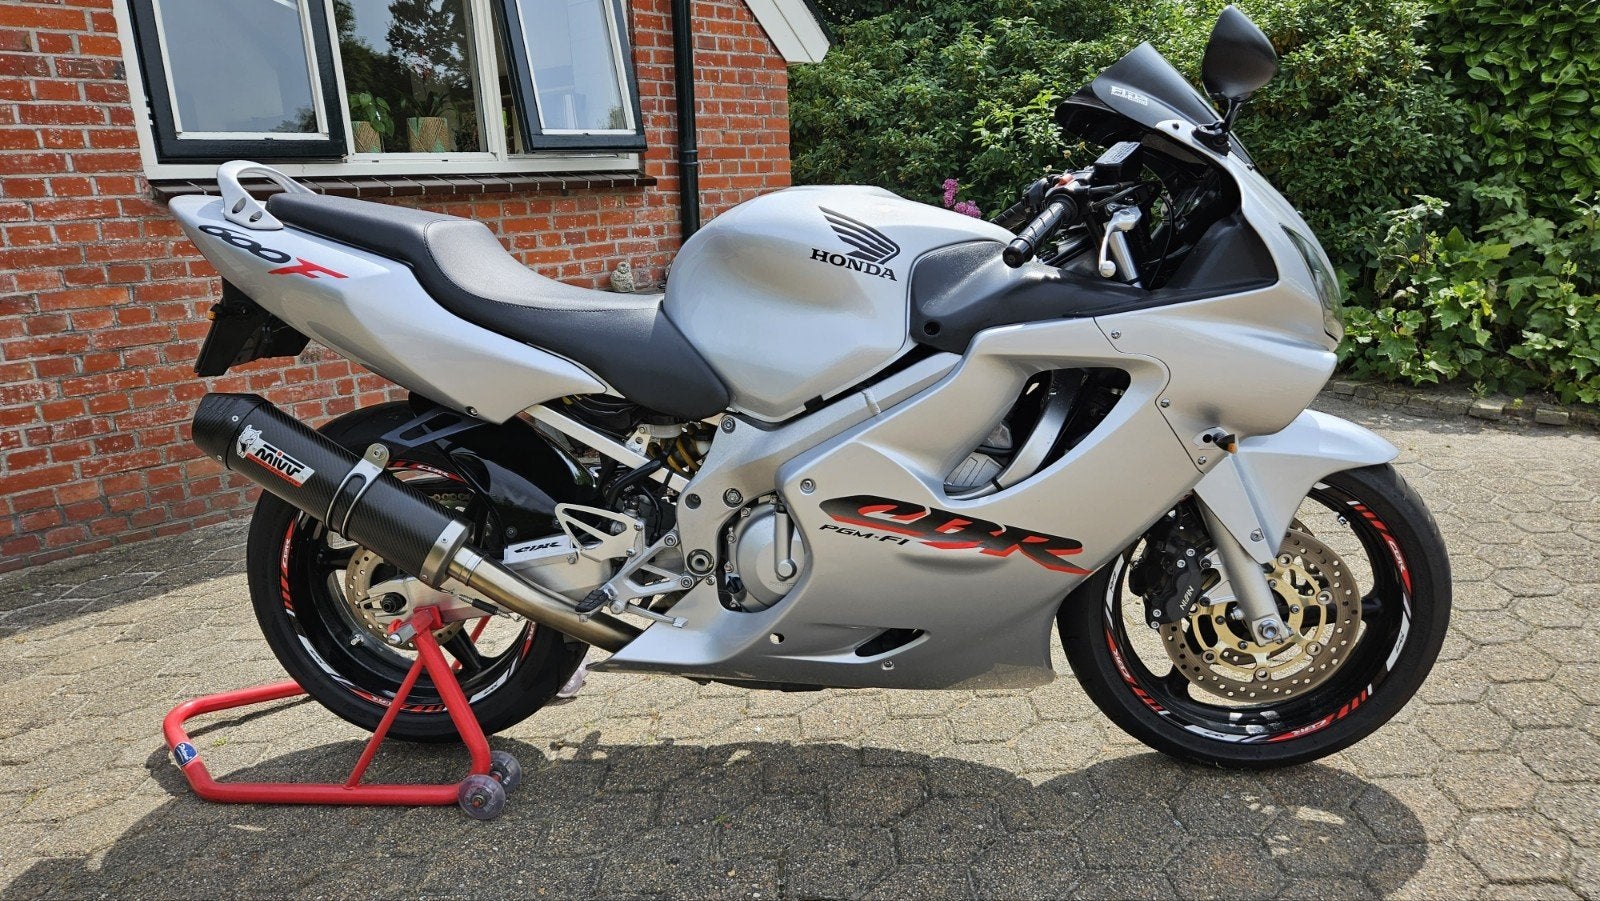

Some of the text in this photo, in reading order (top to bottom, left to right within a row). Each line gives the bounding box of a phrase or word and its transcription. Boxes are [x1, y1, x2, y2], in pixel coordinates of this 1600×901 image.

[810, 248, 898, 282] HONDA
[818, 523, 911, 546] PGM-FI
[818, 494, 1094, 576] CBR
